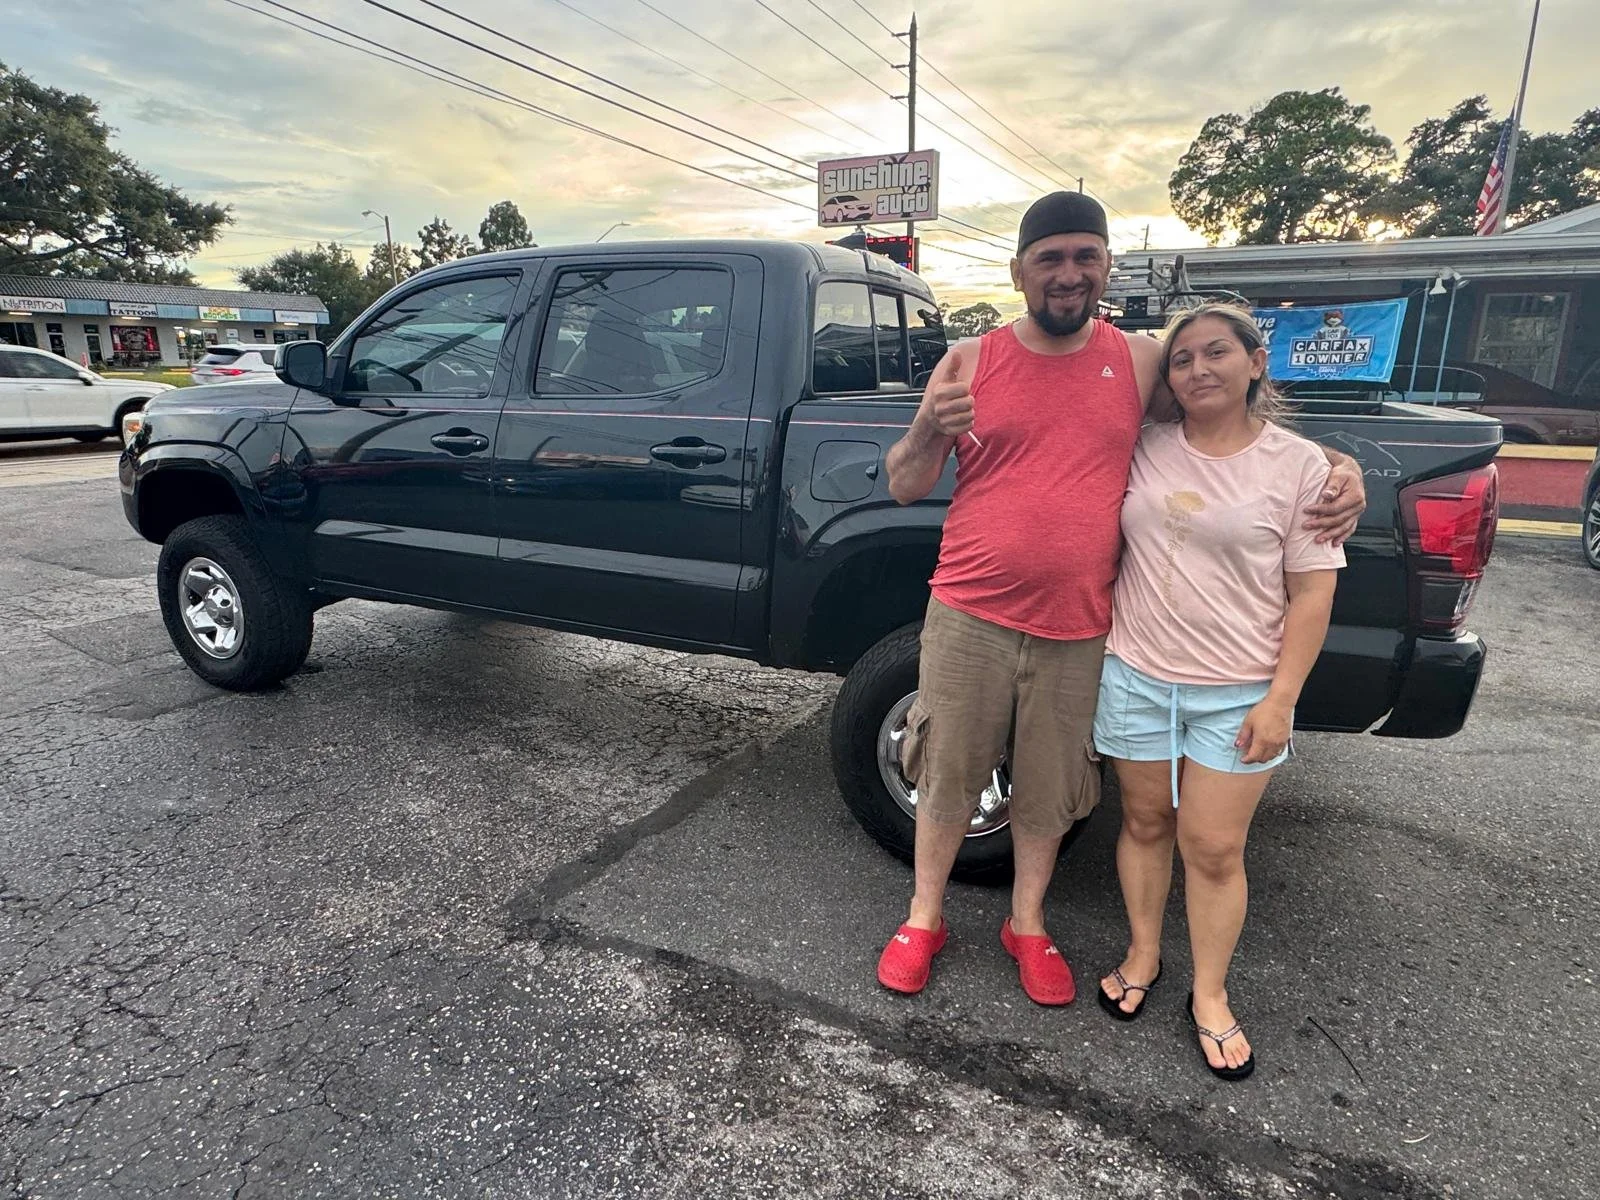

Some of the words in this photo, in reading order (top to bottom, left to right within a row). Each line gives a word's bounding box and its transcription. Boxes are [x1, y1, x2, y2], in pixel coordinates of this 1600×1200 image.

[823, 159, 930, 194] sunshine
[876, 191, 929, 215] auto
[2, 298, 65, 310] NUTRITION
[1295, 340, 1367, 351] CARFAX
[1306, 353, 1364, 364] OWNER
